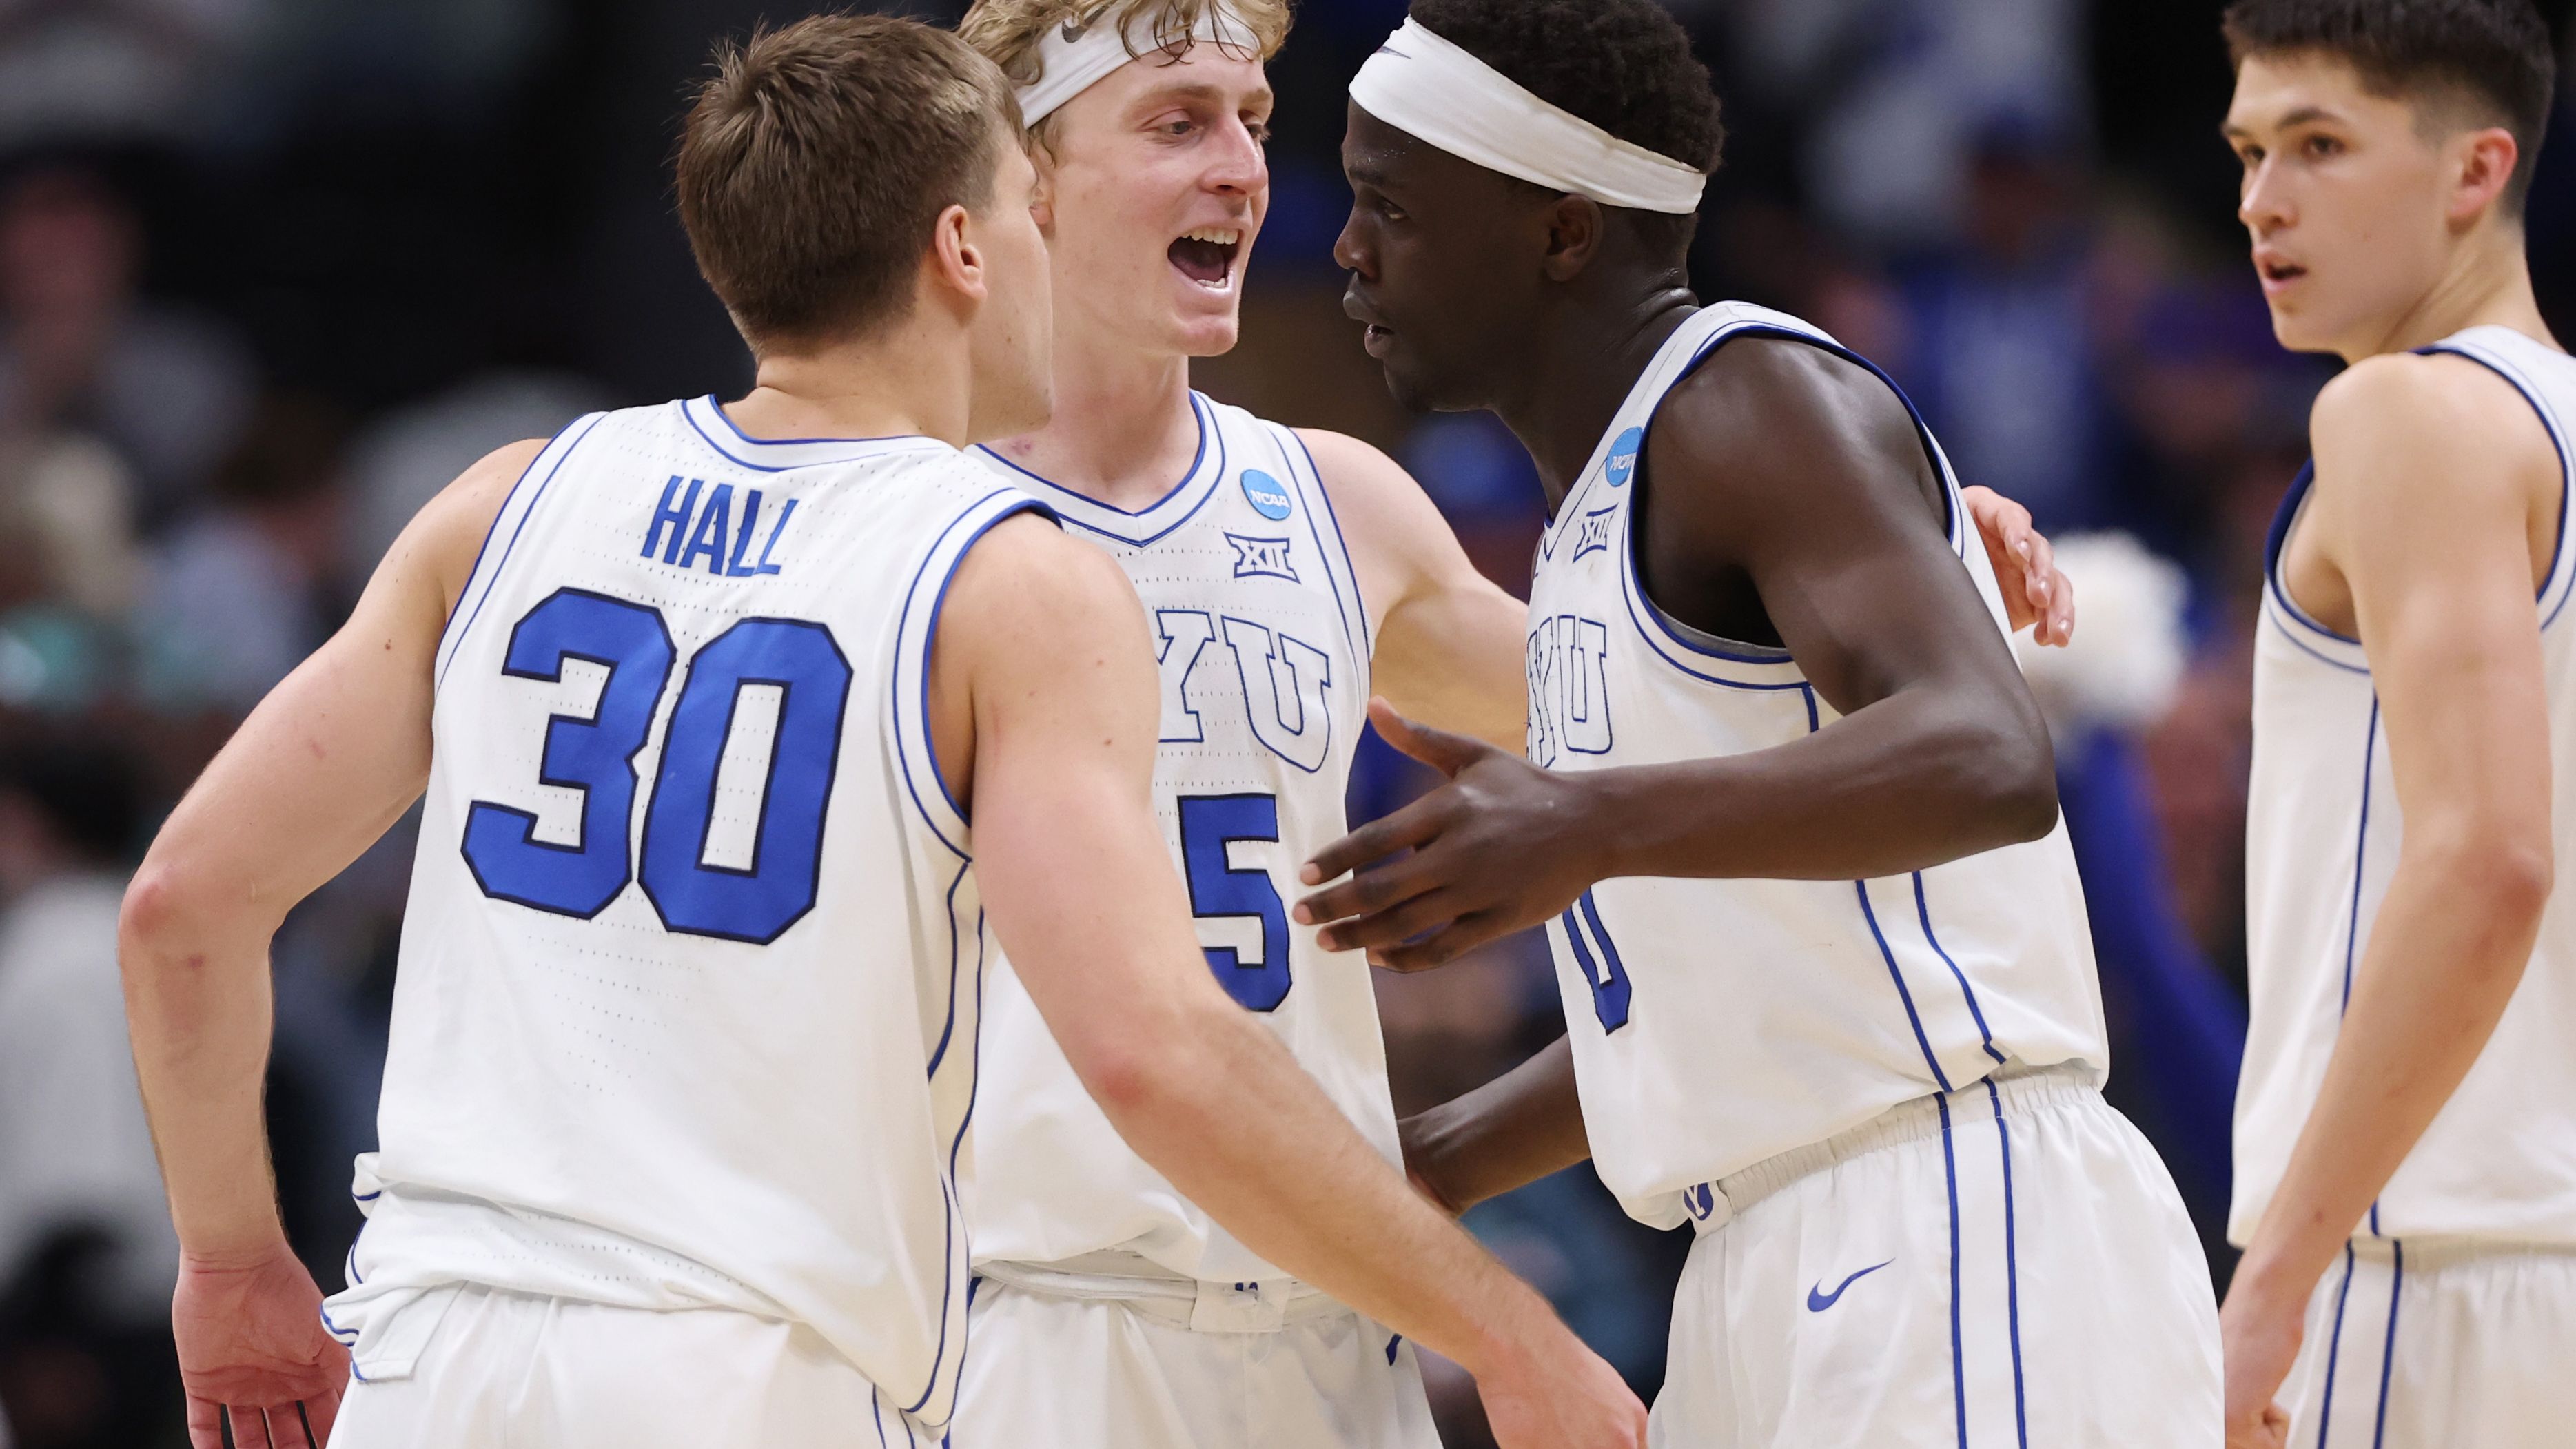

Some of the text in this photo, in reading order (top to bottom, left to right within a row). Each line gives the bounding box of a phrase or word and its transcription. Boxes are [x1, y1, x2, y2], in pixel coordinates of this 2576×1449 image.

[642, 475, 799, 577] HALL
[1249, 489, 1290, 508] NCAA
[1573, 502, 1619, 563] XII
[1223, 531, 1302, 585] XII
[1156, 610, 1331, 773] YU
[1526, 615, 1613, 769] YU
[460, 586, 854, 946] 30
